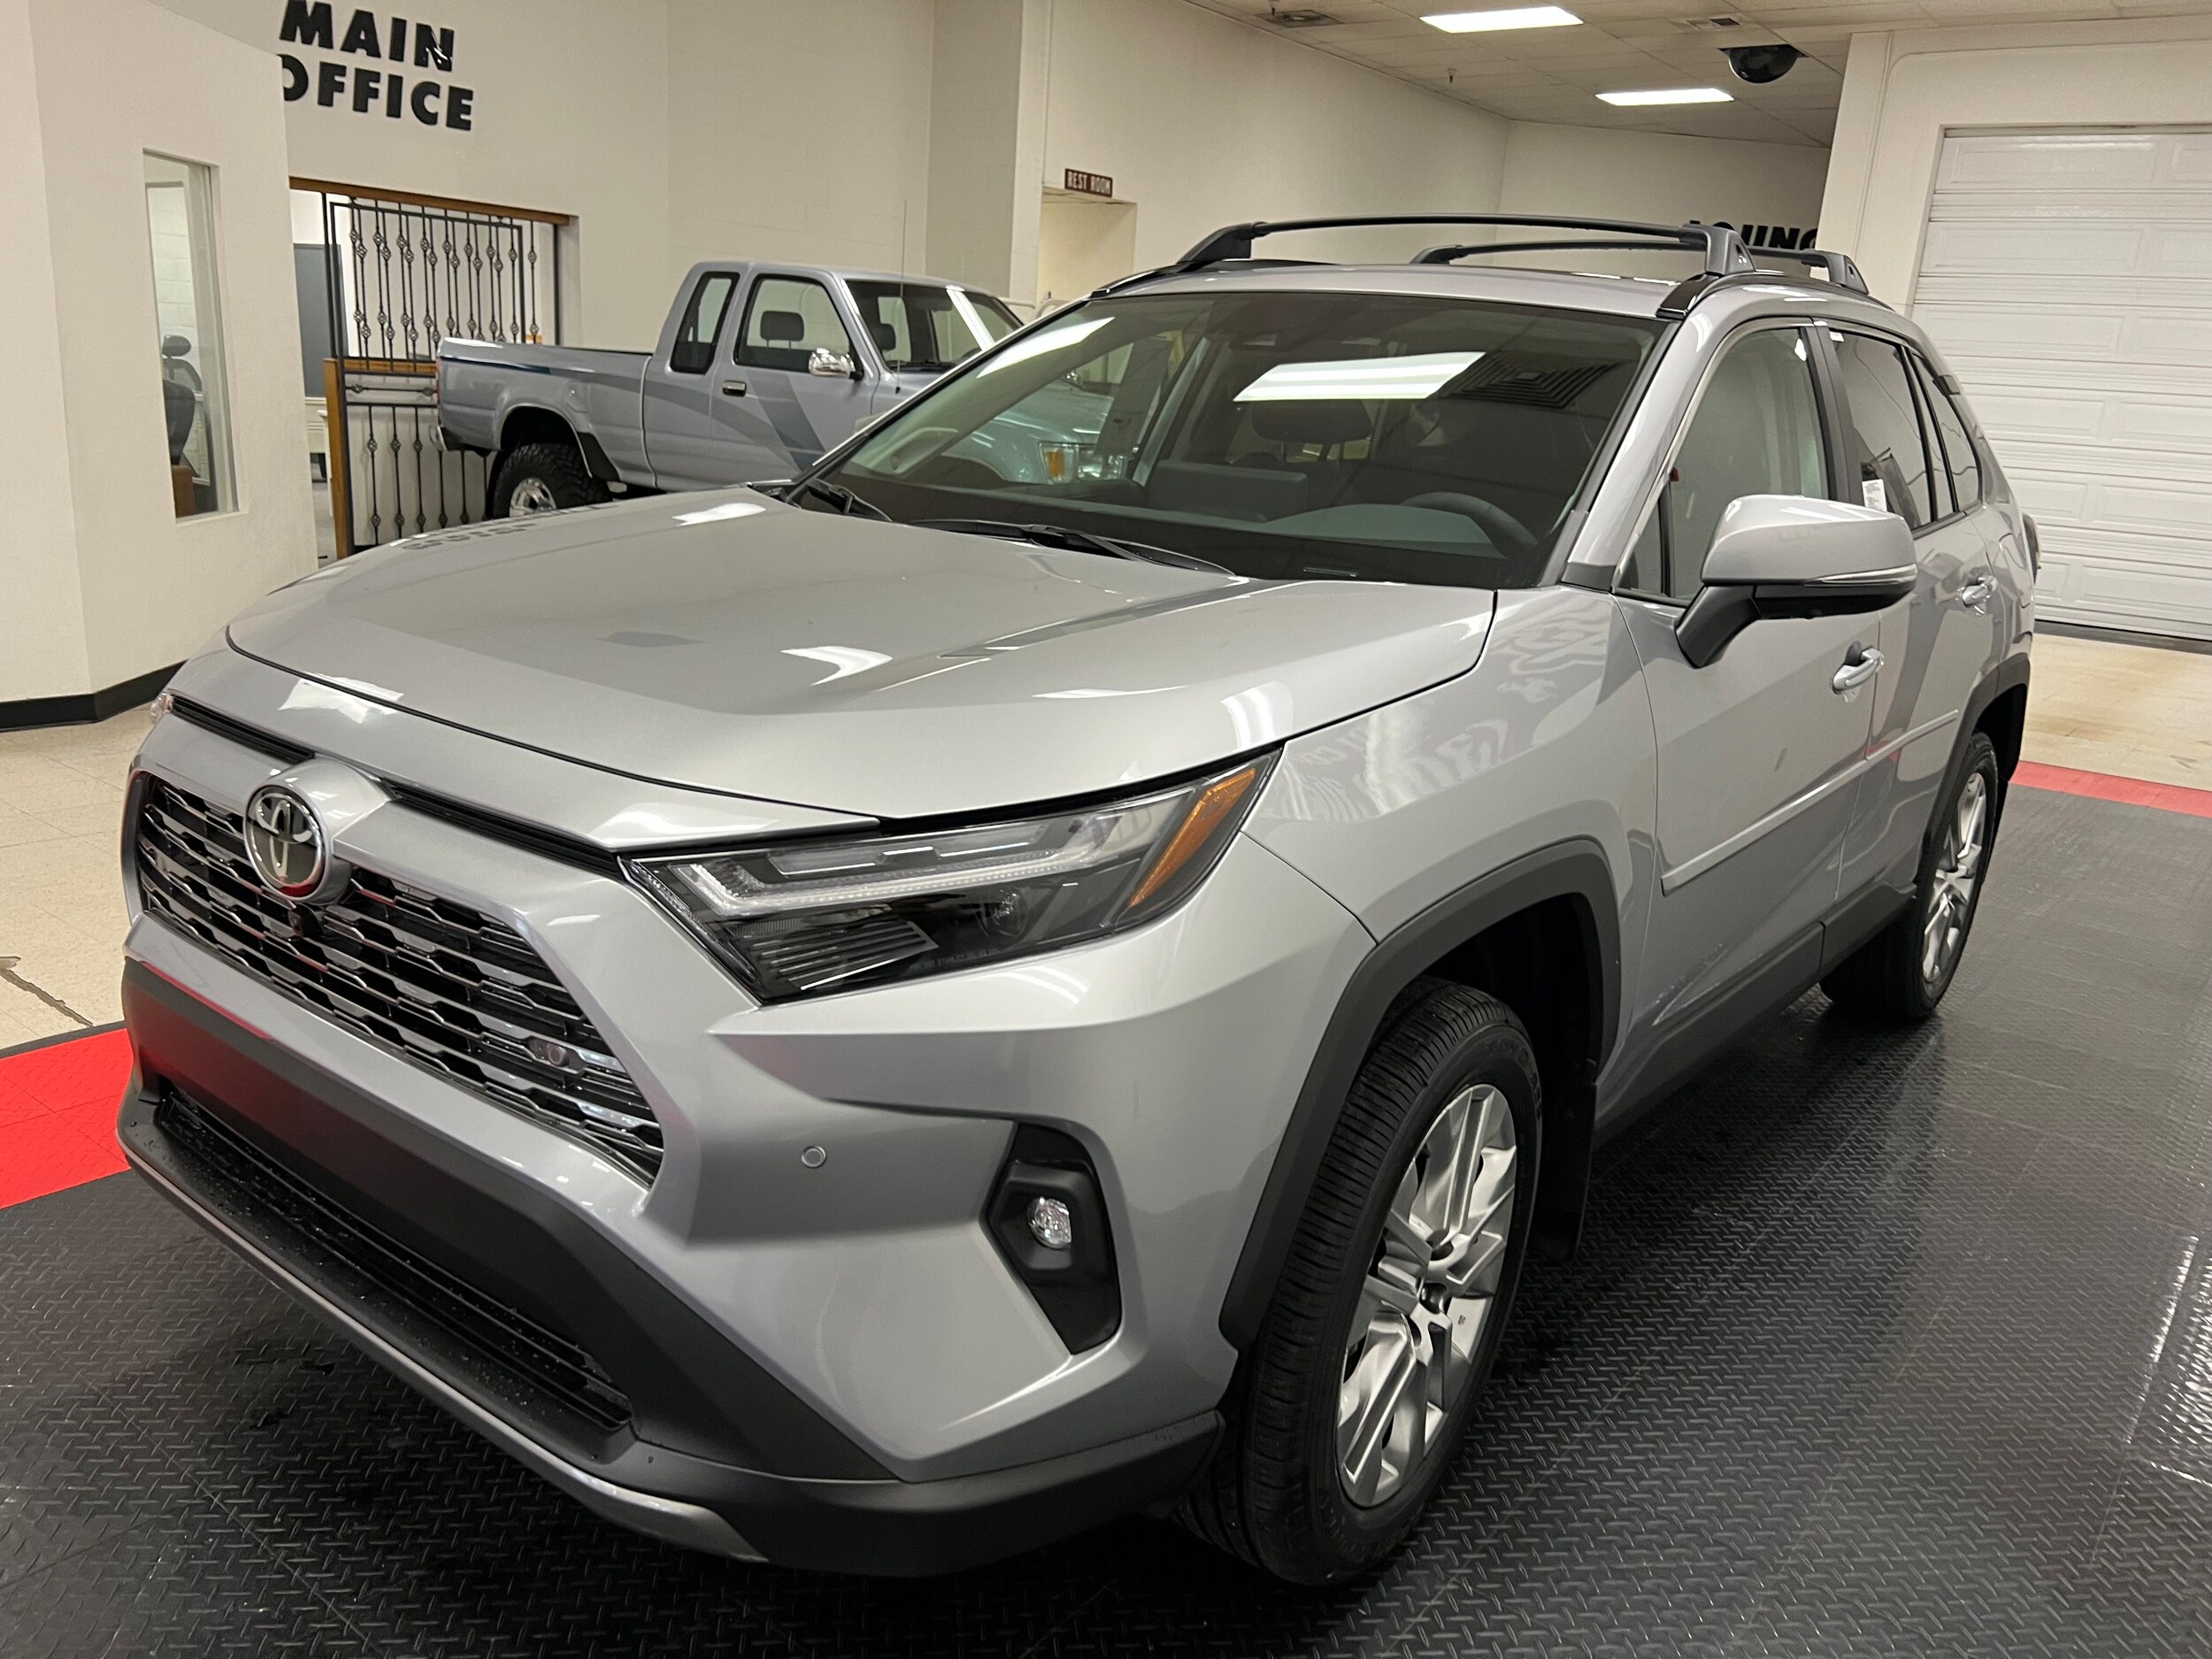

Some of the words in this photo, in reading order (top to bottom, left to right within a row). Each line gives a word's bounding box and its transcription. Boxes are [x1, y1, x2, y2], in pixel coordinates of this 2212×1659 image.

[279, 0, 455, 73] MAIN
[276, 53, 473, 132] OFFICE
[1067, 171, 1087, 190] REST
